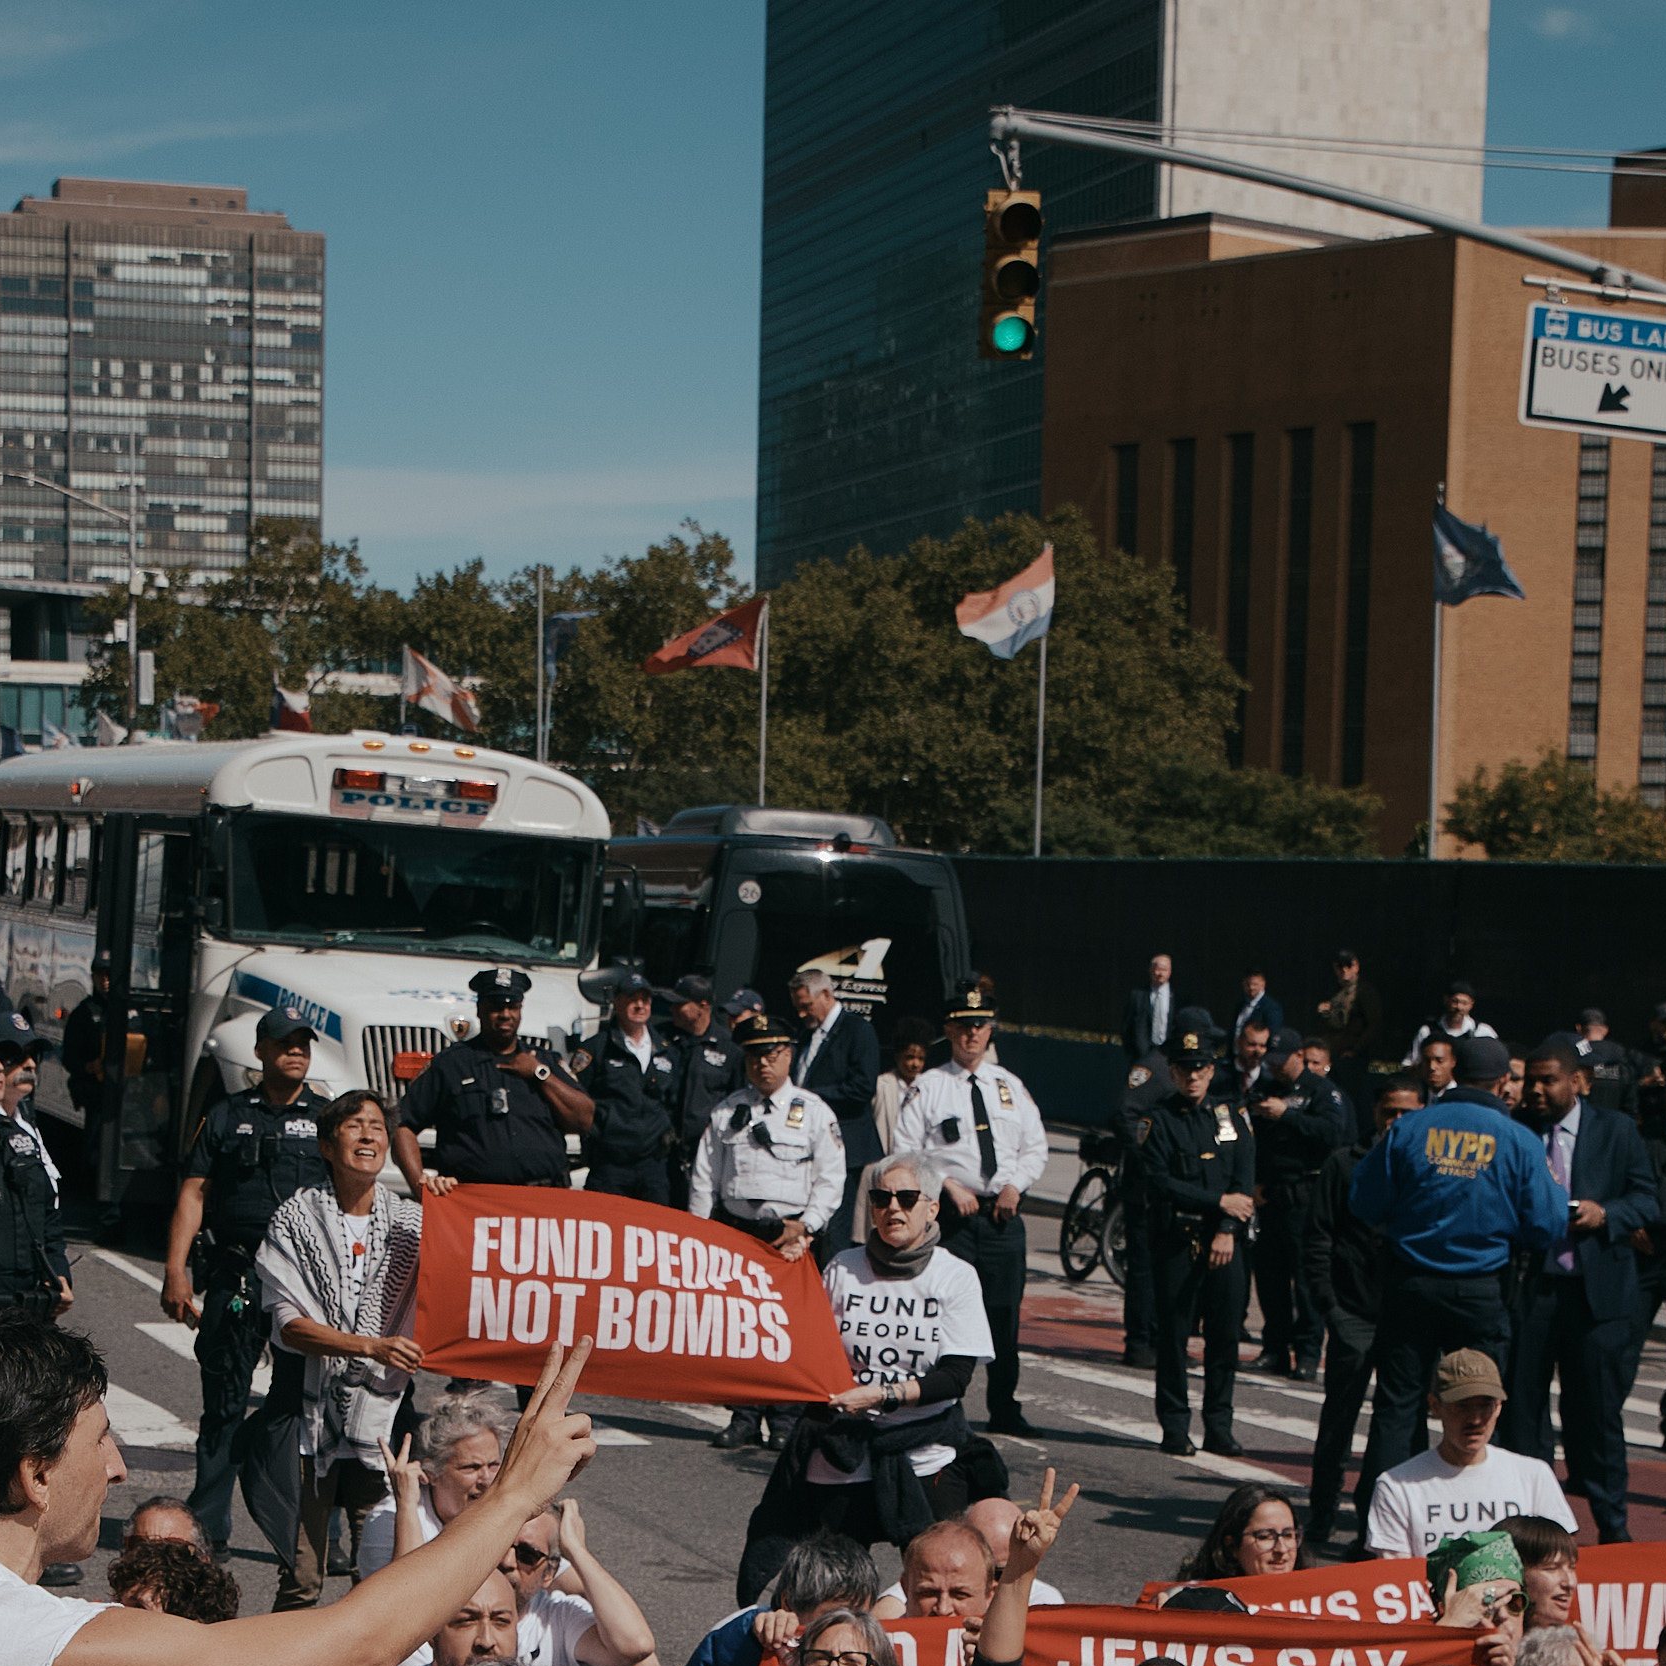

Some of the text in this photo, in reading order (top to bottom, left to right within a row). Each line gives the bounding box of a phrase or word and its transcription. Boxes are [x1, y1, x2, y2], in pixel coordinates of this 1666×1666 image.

[1577, 319, 1622, 341] BUS
[1541, 346, 1620, 376] BUSES
[340, 791, 490, 817] POLICE
[741, 882, 761, 899] 26
[280, 988, 328, 1031] POLICE
[284, 1121, 318, 1134] POLIC
[1425, 1127, 1497, 1164] NYPD
[1427, 1155, 1491, 1171] COMMUNITY
[1436, 1165, 1477, 1180] AFFAIRS
[471, 1216, 783, 1301] FUND PEOPLE
[845, 1294, 939, 1319] FUND
[468, 1276, 793, 1364] NOT BOMBS
[840, 1321, 941, 1343] PEOPLE
[852, 1346, 926, 1368] NOT
[1426, 1501, 1522, 1524] FUND
[1373, 1580, 1436, 1625] SA
